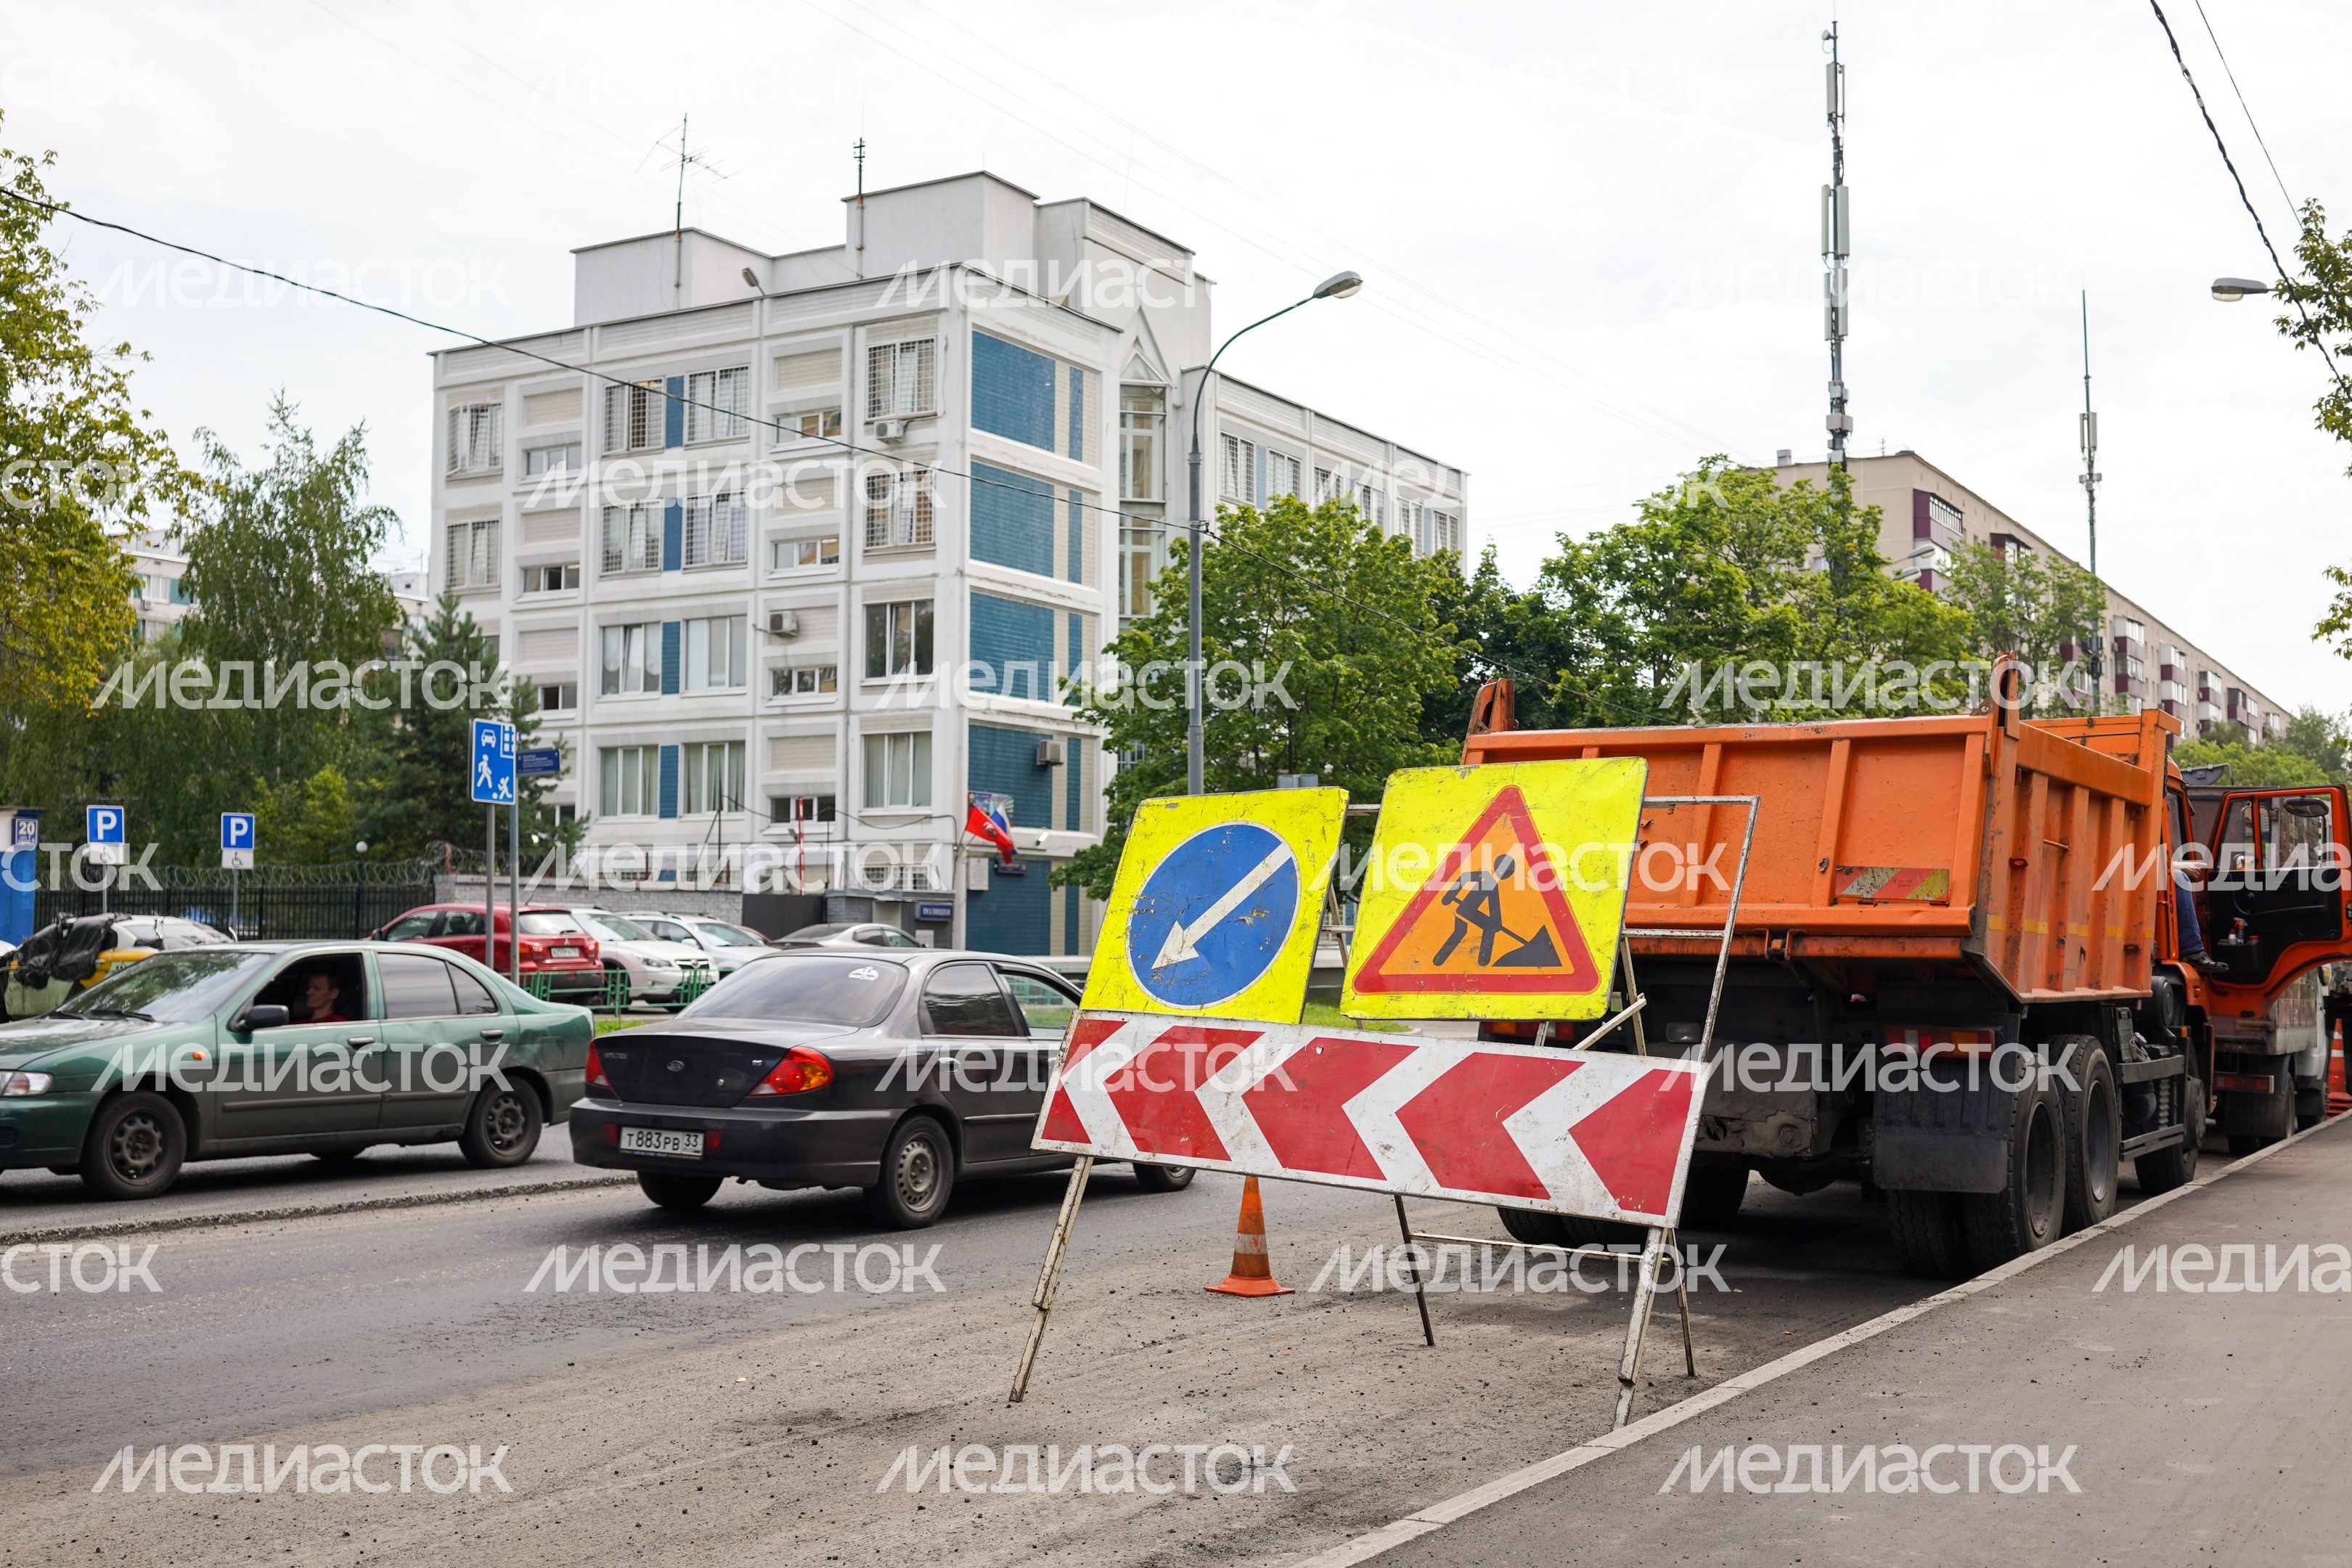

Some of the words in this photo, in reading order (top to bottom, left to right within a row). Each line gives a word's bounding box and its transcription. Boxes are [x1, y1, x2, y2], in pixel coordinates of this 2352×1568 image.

[19, 821, 35, 836] 20
[97, 810, 117, 840] P
[230, 817, 248, 846] P
[685, 1133, 698, 1147] 33
